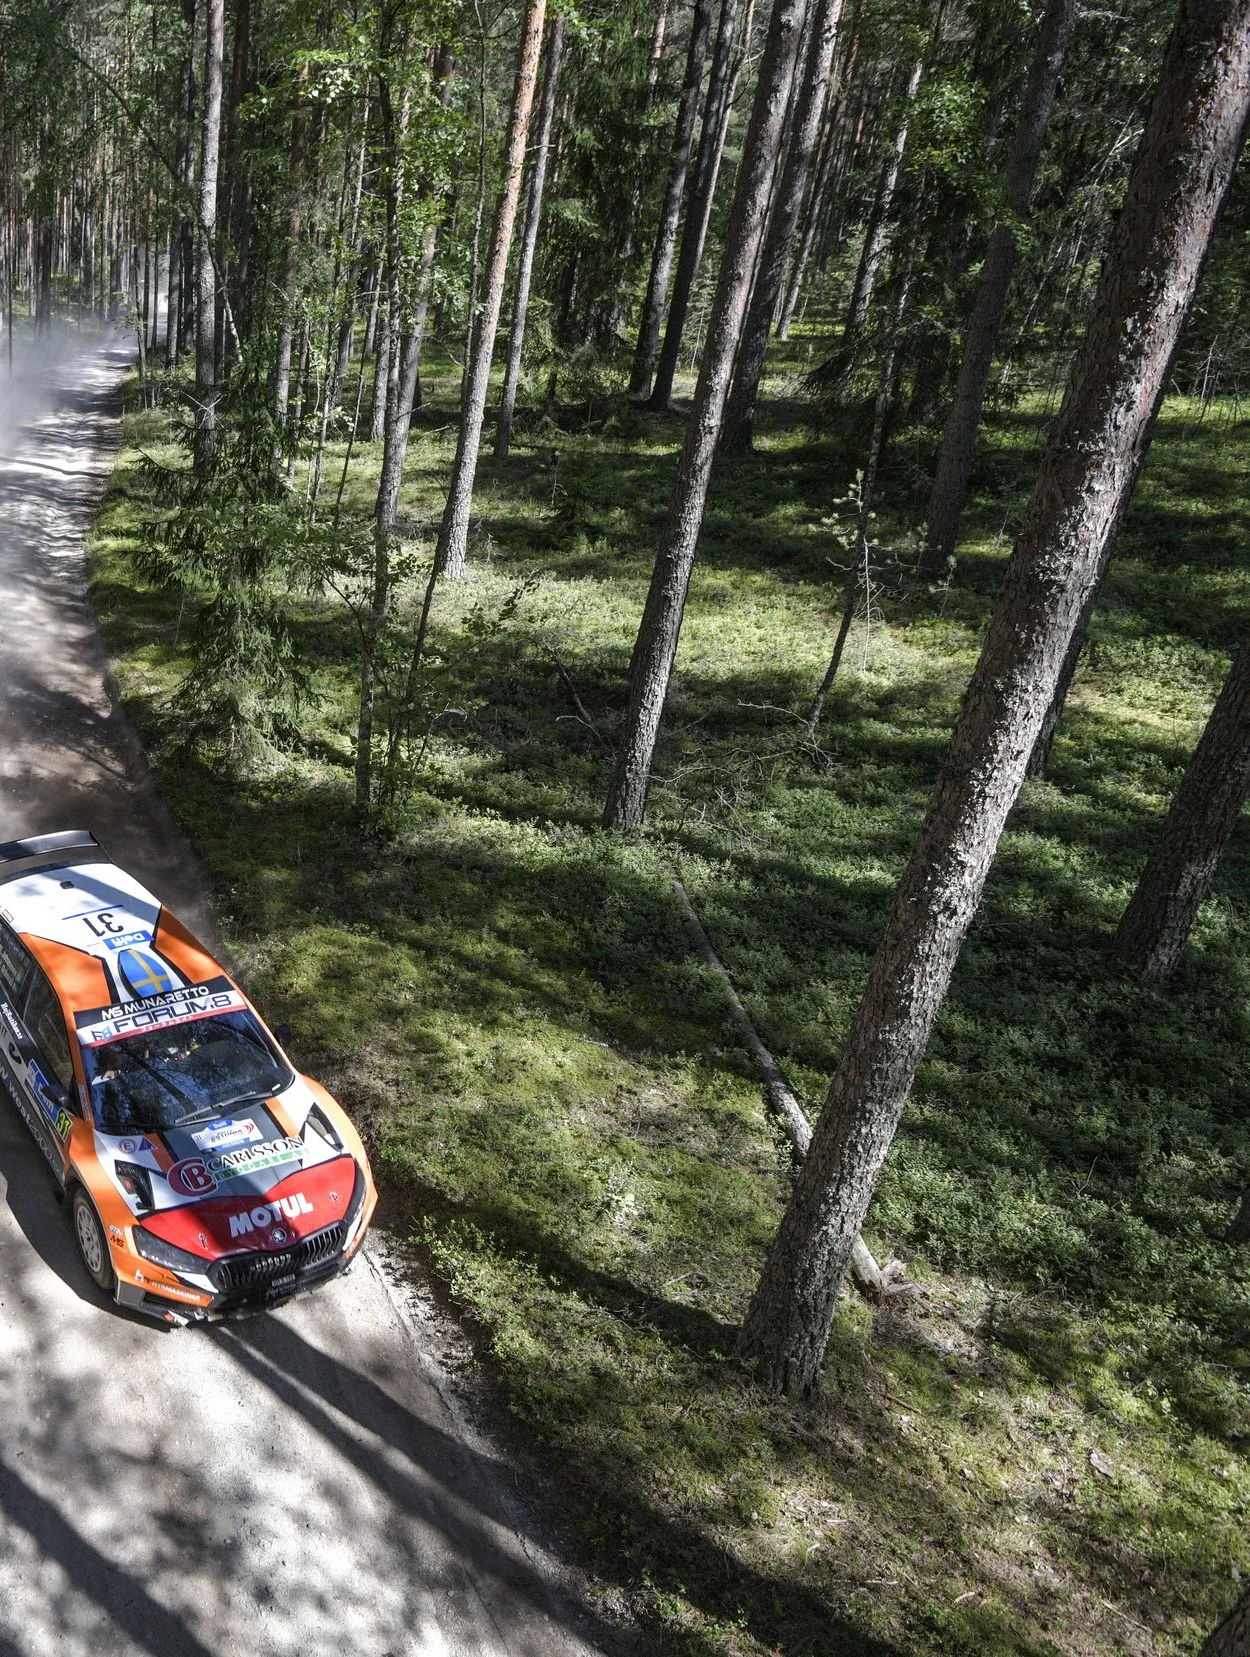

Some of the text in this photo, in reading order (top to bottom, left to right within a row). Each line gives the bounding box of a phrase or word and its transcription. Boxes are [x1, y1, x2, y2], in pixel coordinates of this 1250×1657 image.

[82, 912, 124, 937] 31
[110, 932, 146, 948] Delfi
[101, 985, 210, 1021] MS MUNARETTO
[113, 994, 232, 1033] FORUM8
[57, 1111, 70, 1138] 31
[207, 1136, 304, 1171] CARLSSON
[228, 1192, 314, 1238] MOTUL
[110, 1235, 125, 1248] MS
